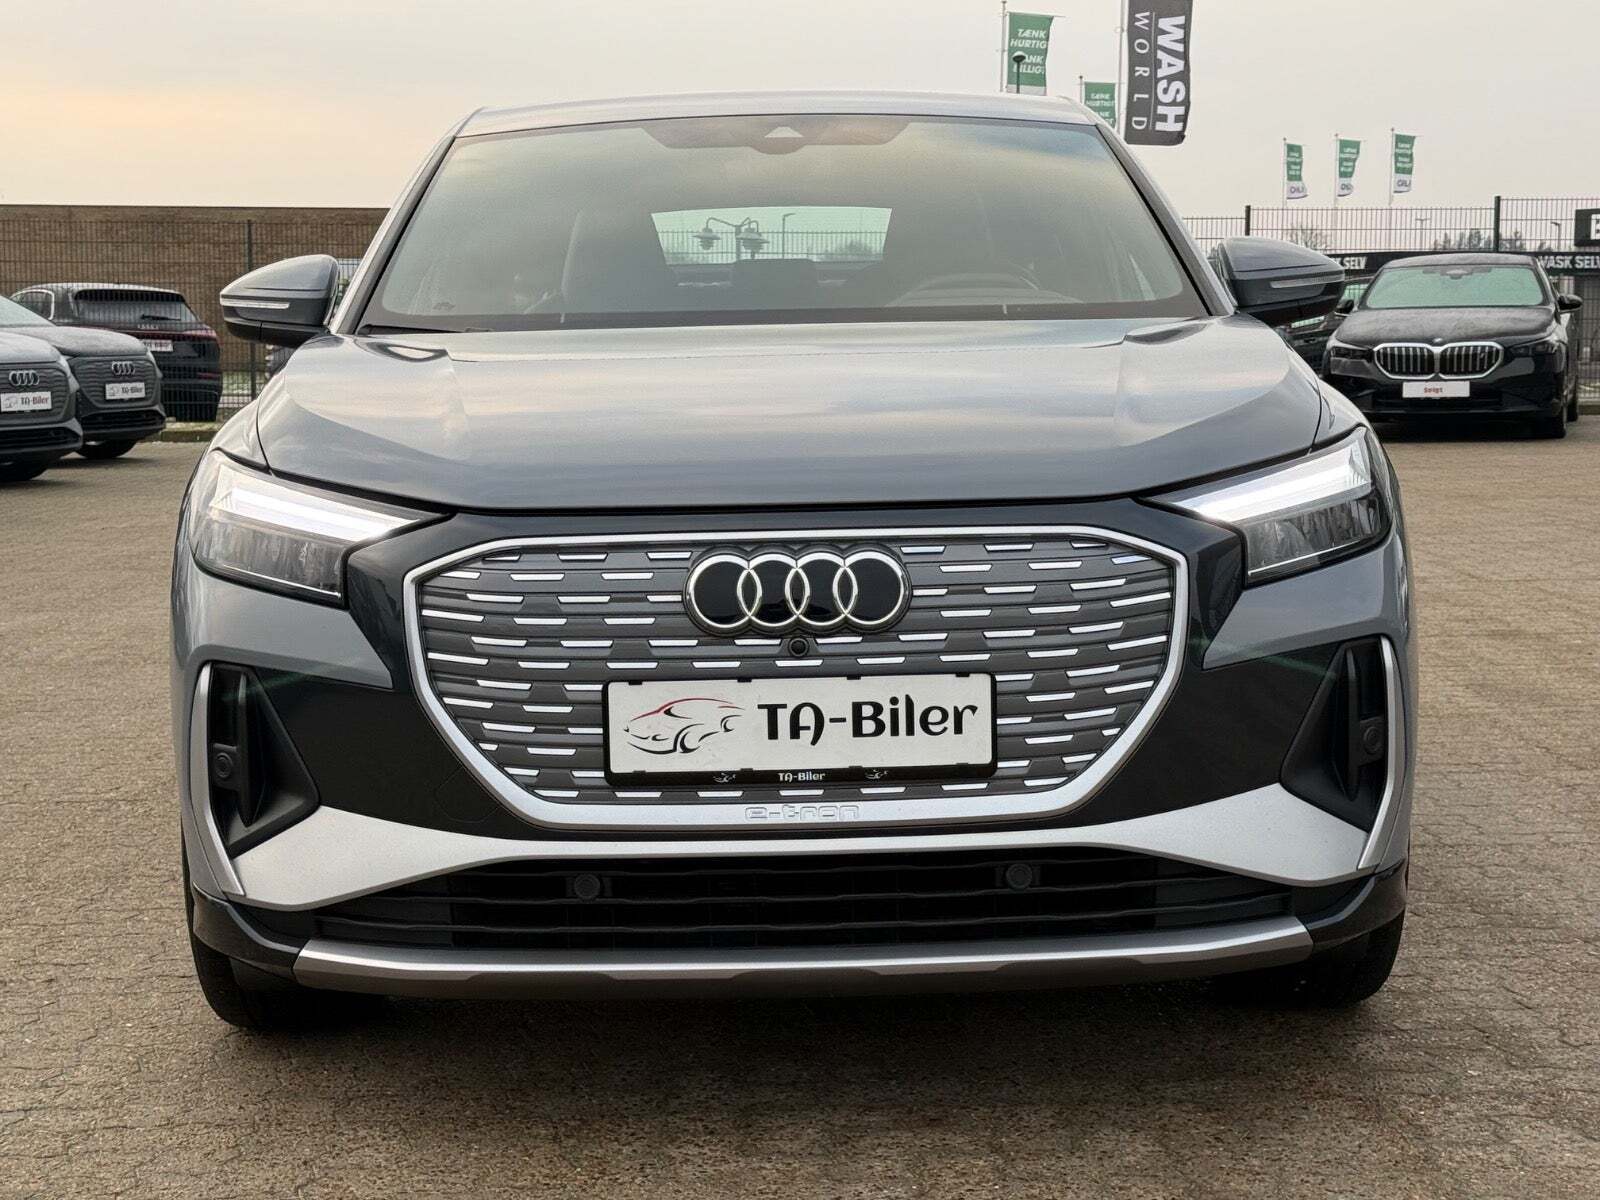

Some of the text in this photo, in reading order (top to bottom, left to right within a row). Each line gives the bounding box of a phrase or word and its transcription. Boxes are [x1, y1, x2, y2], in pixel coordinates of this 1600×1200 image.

[1009, 38, 1048, 49] HURTIG
[1131, 11, 1150, 131] WORLD
[1155, 15, 1186, 132] WASH
[1343, 256, 1368, 270] SELV
[757, 693, 979, 747] TA-Biler
[777, 770, 827, 783] TA-Biler
[744, 803, 861, 821] e-tron
